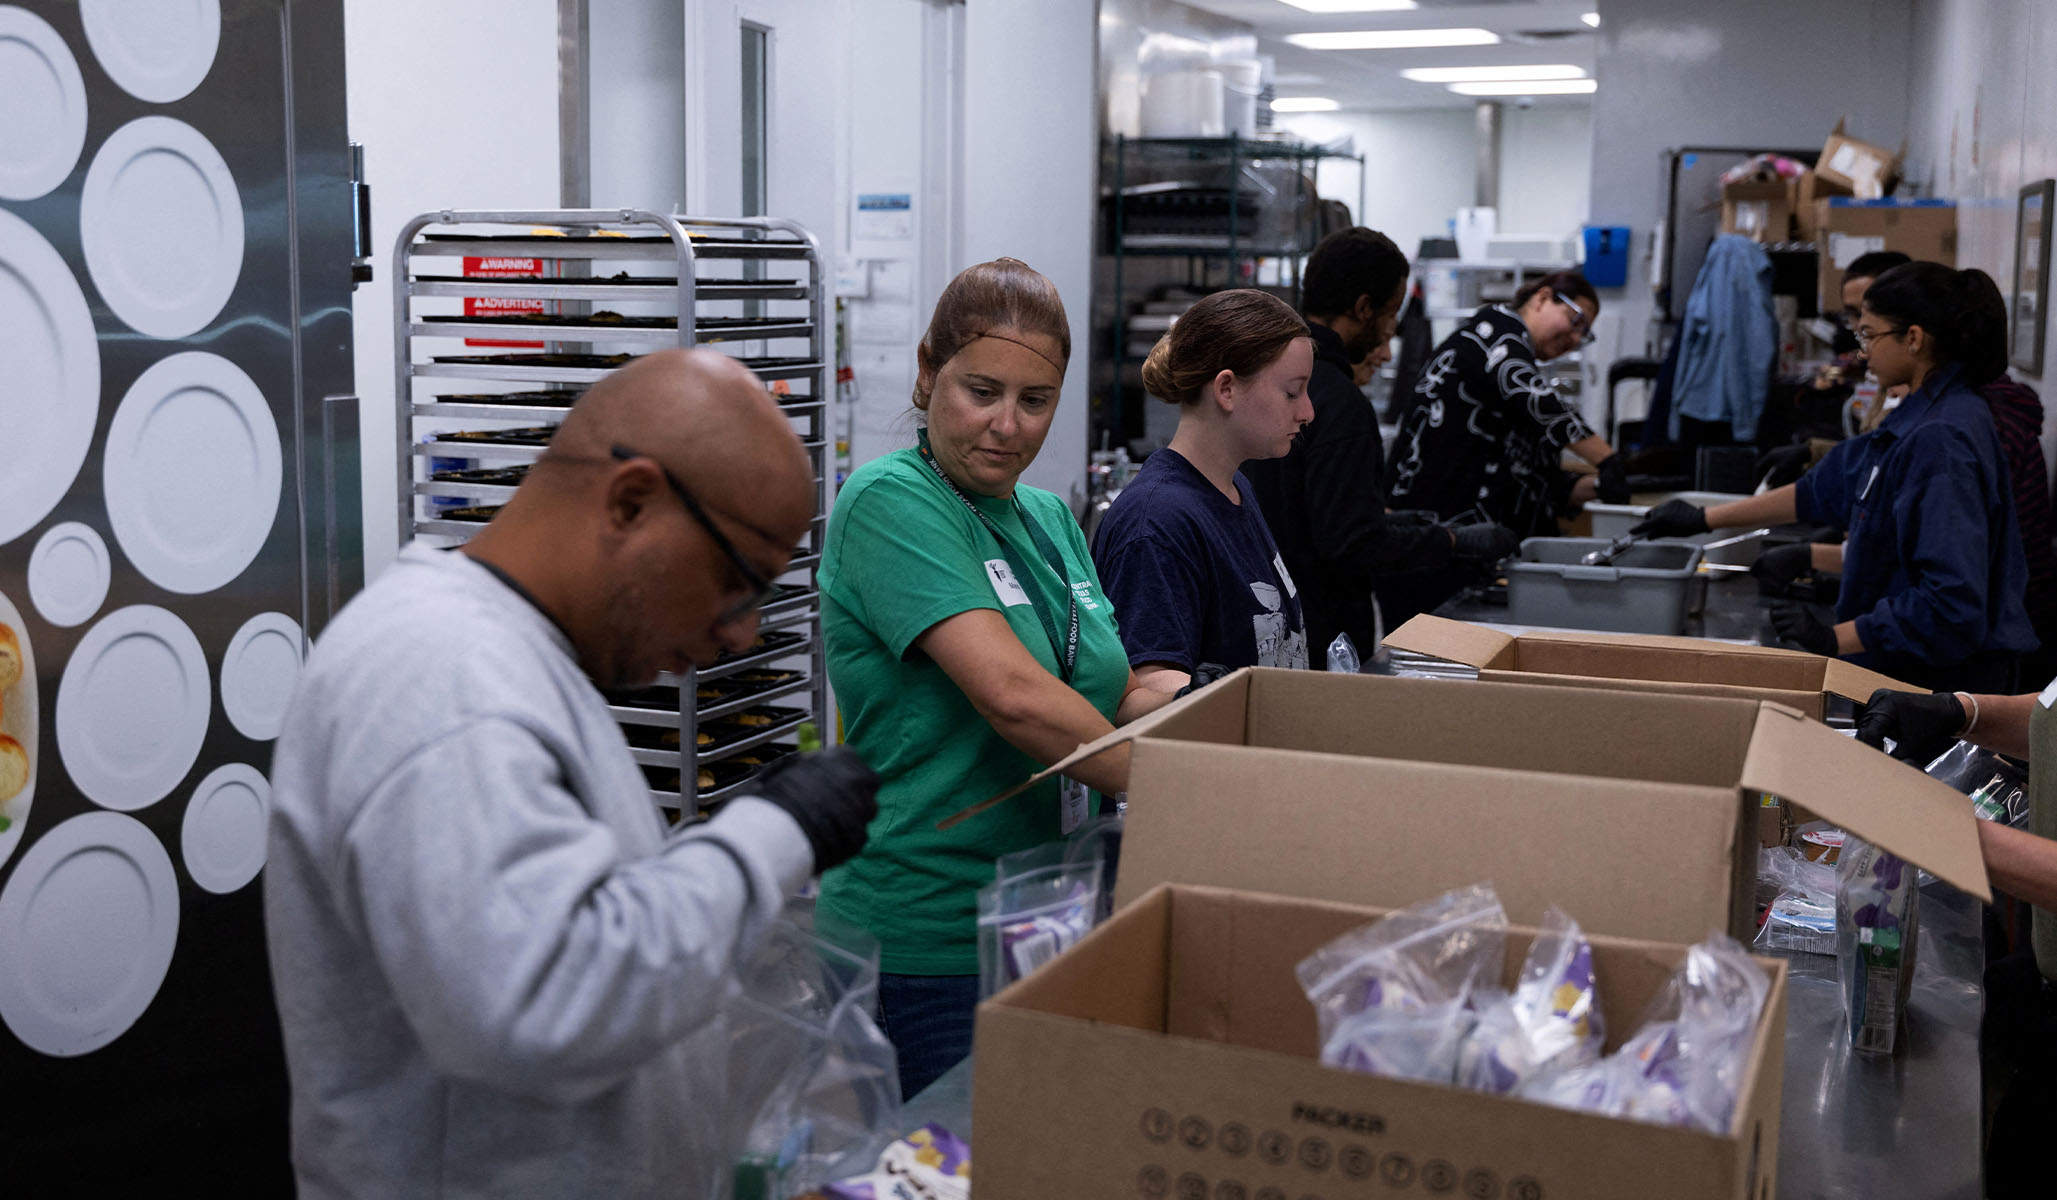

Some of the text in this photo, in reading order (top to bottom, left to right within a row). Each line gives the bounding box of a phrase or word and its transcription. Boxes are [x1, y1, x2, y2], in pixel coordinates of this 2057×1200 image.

[488, 258, 535, 270] WARNING
[928, 457, 944, 477] BANK
[1069, 622, 1078, 644] FOOD
[1066, 645, 1076, 667] BANK
[1294, 1103, 1385, 1135] PACKER
